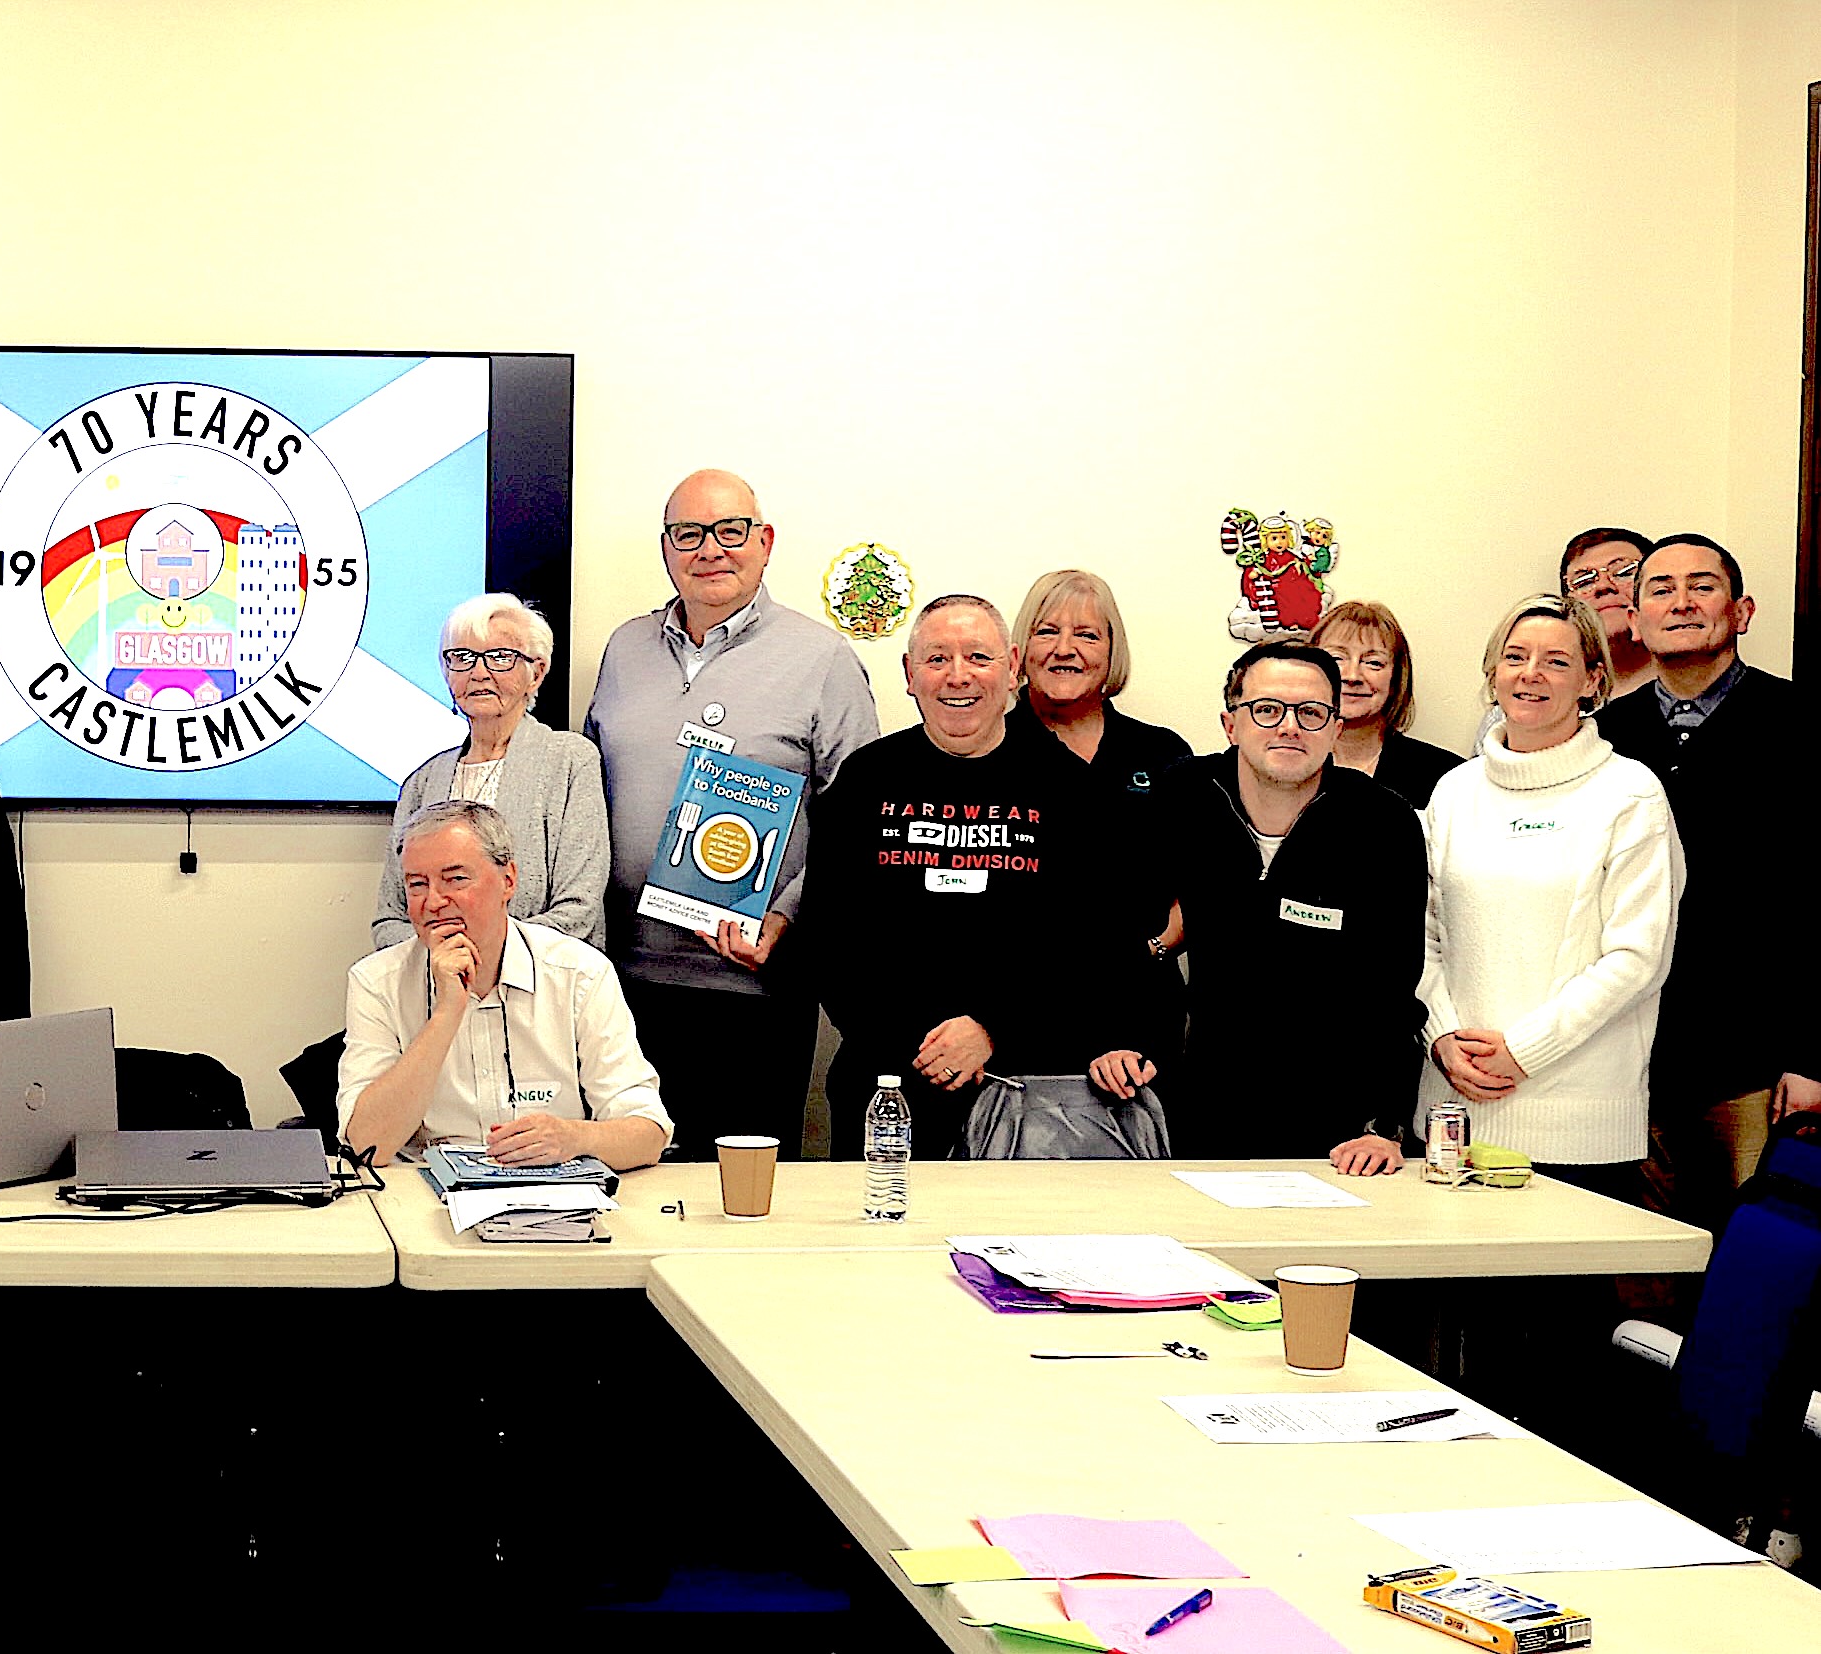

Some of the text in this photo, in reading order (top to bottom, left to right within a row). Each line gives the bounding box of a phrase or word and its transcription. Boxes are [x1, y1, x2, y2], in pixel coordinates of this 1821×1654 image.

[48, 390, 302, 475] 70 YEARS
[312, 558, 358, 588] 55
[119, 634, 229, 665] GLASGOW
[28, 661, 323, 764] CASTLEMILK
[693, 756, 791, 799] Why people go
[693, 777, 780, 813] to foodbanks
[881, 801, 1040, 824] HARDWEAR
[946, 824, 1012, 847] DIESEL
[878, 850, 1039, 873] DENIM DIVISION
